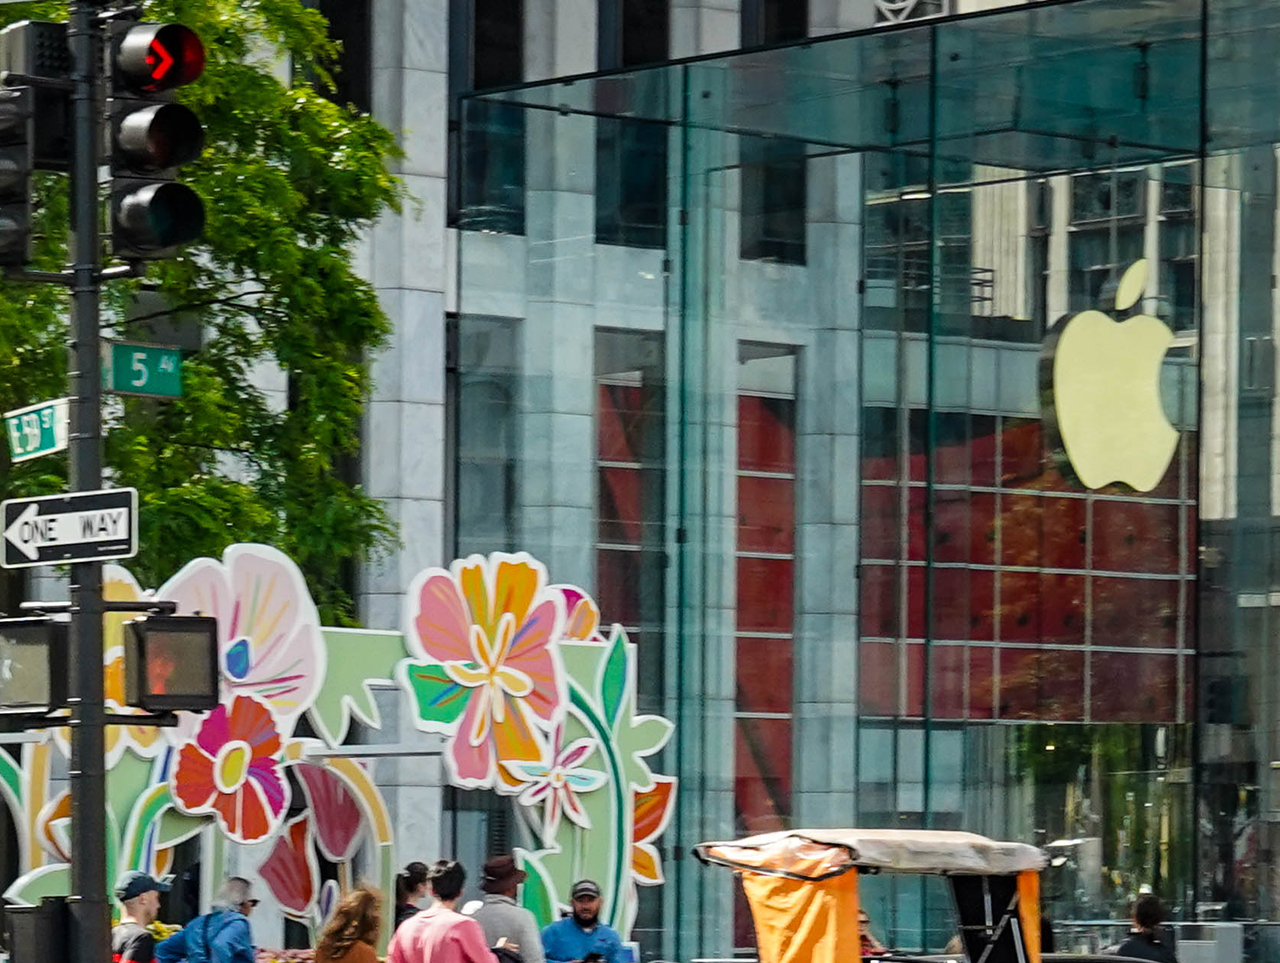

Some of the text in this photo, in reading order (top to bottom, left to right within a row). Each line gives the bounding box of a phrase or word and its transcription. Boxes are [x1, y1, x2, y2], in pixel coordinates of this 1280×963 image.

[131, 352, 149, 387] 5
[19, 511, 124, 544] ONE WAY
